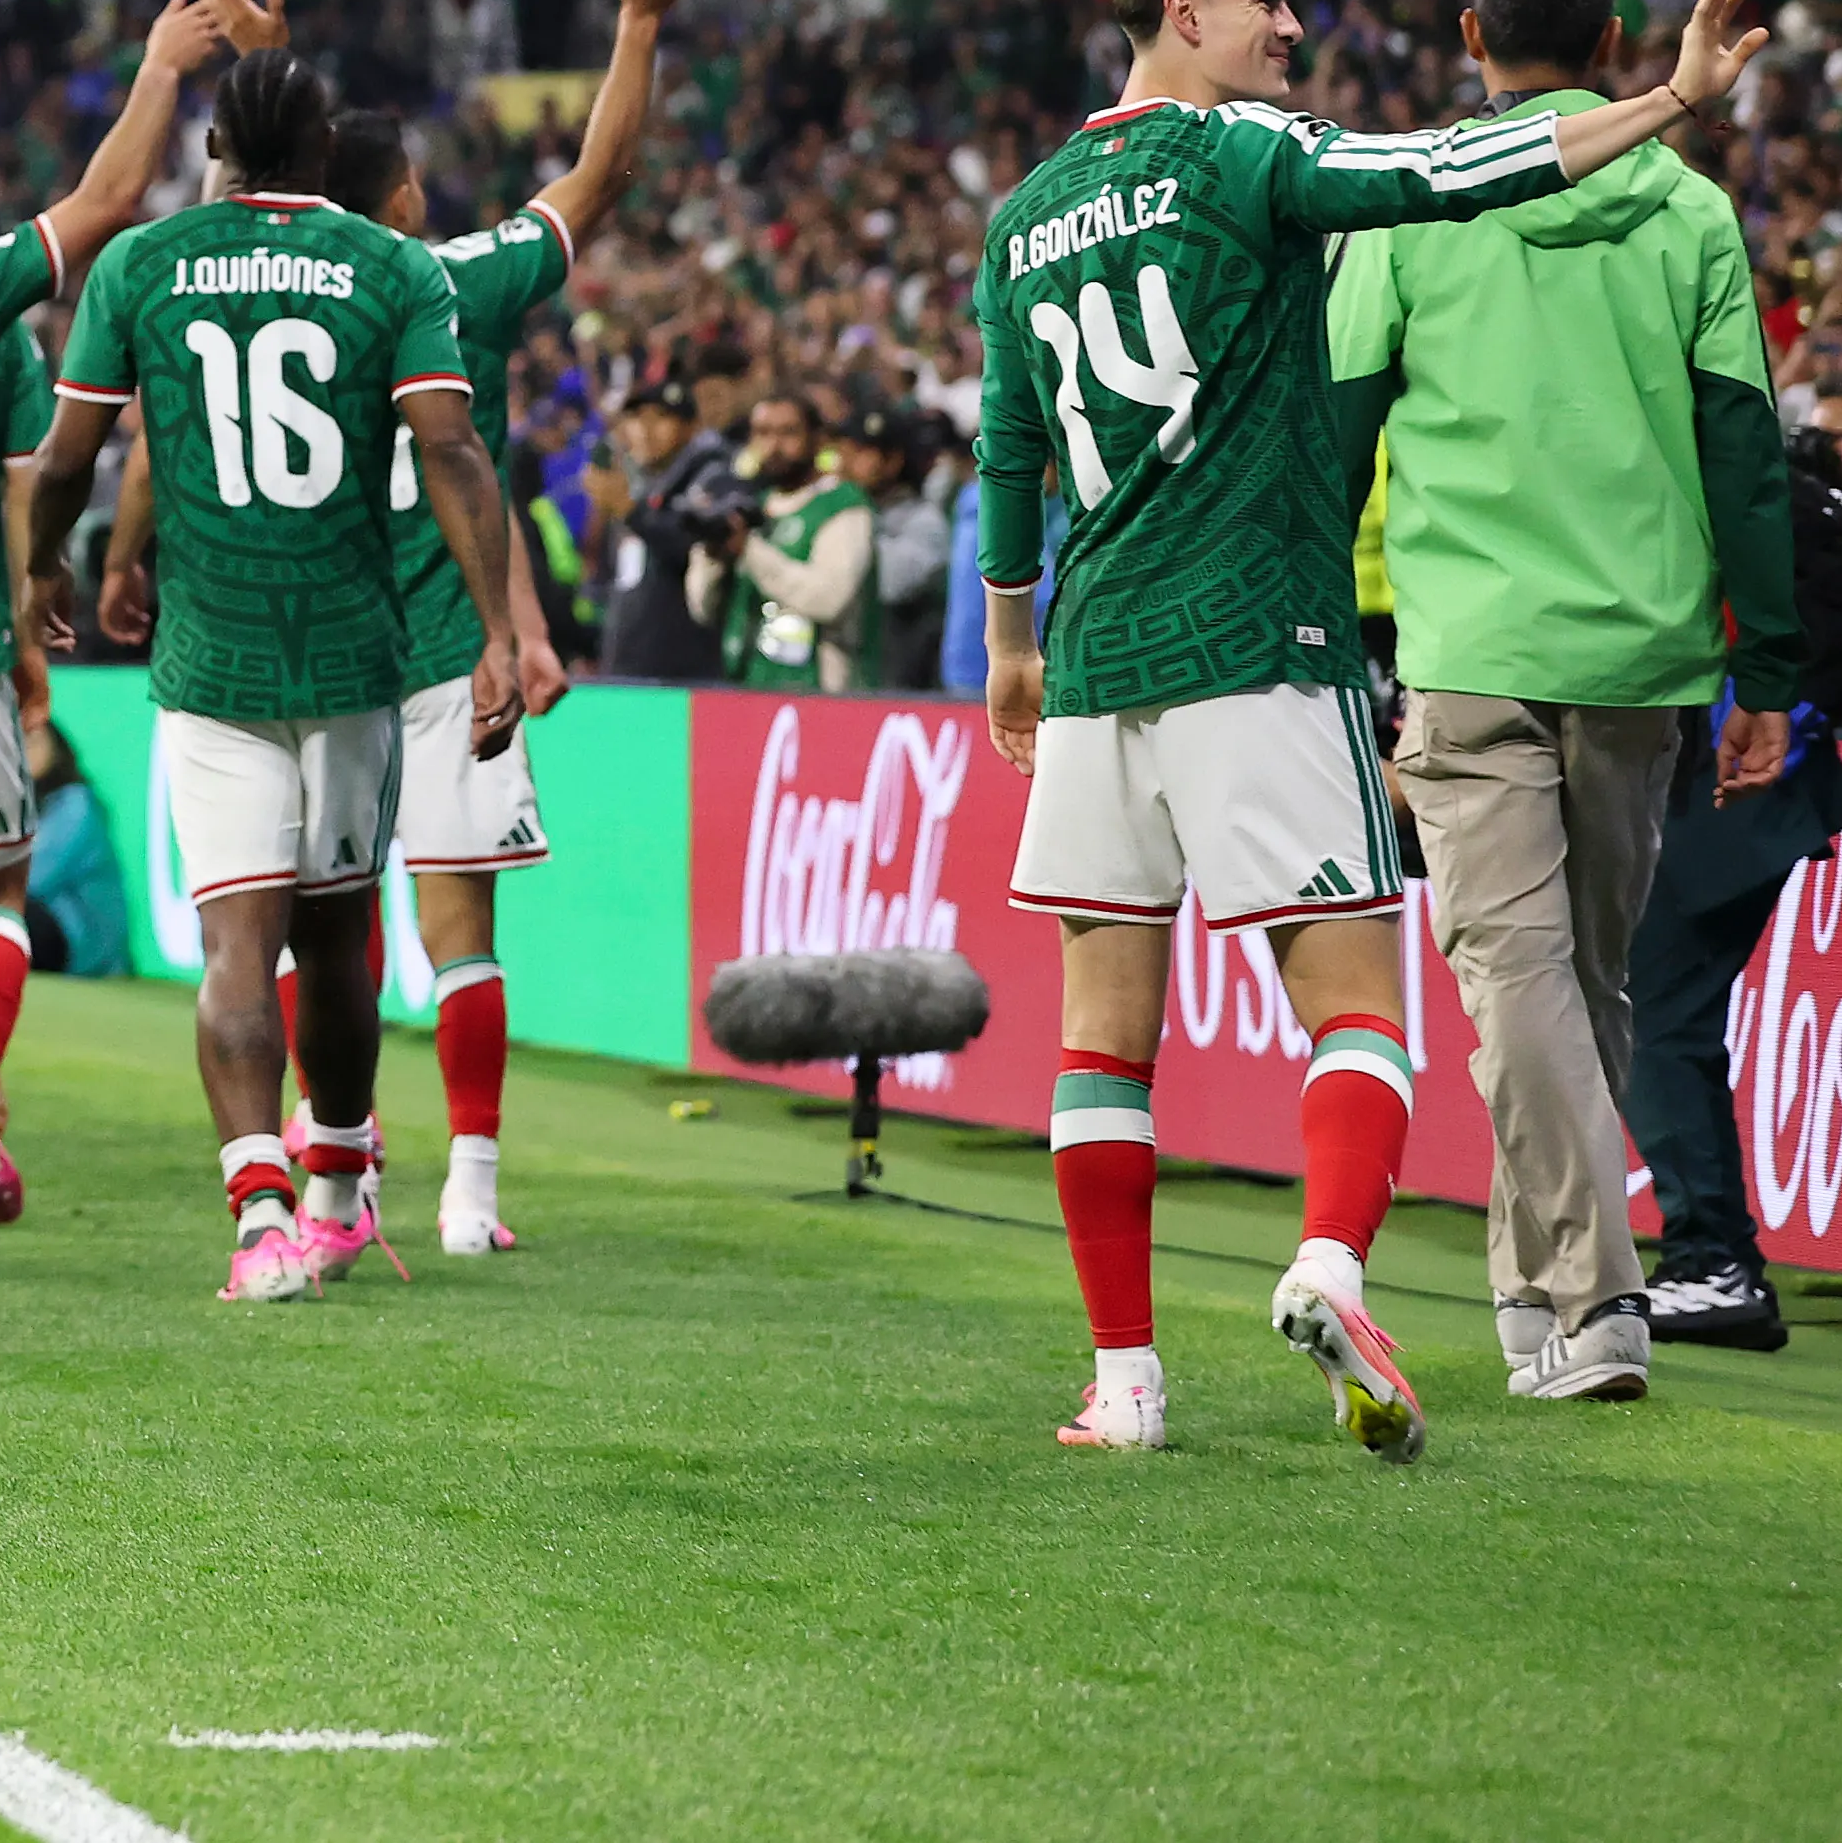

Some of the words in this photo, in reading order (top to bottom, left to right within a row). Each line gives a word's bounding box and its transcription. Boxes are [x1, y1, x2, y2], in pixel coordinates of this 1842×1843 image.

[171, 246, 356, 301] J.QUIÑONES
[1008, 177, 1181, 281] R.GONZÁLEZ
[184, 316, 345, 510] 16
[1030, 264, 1201, 511] 14
